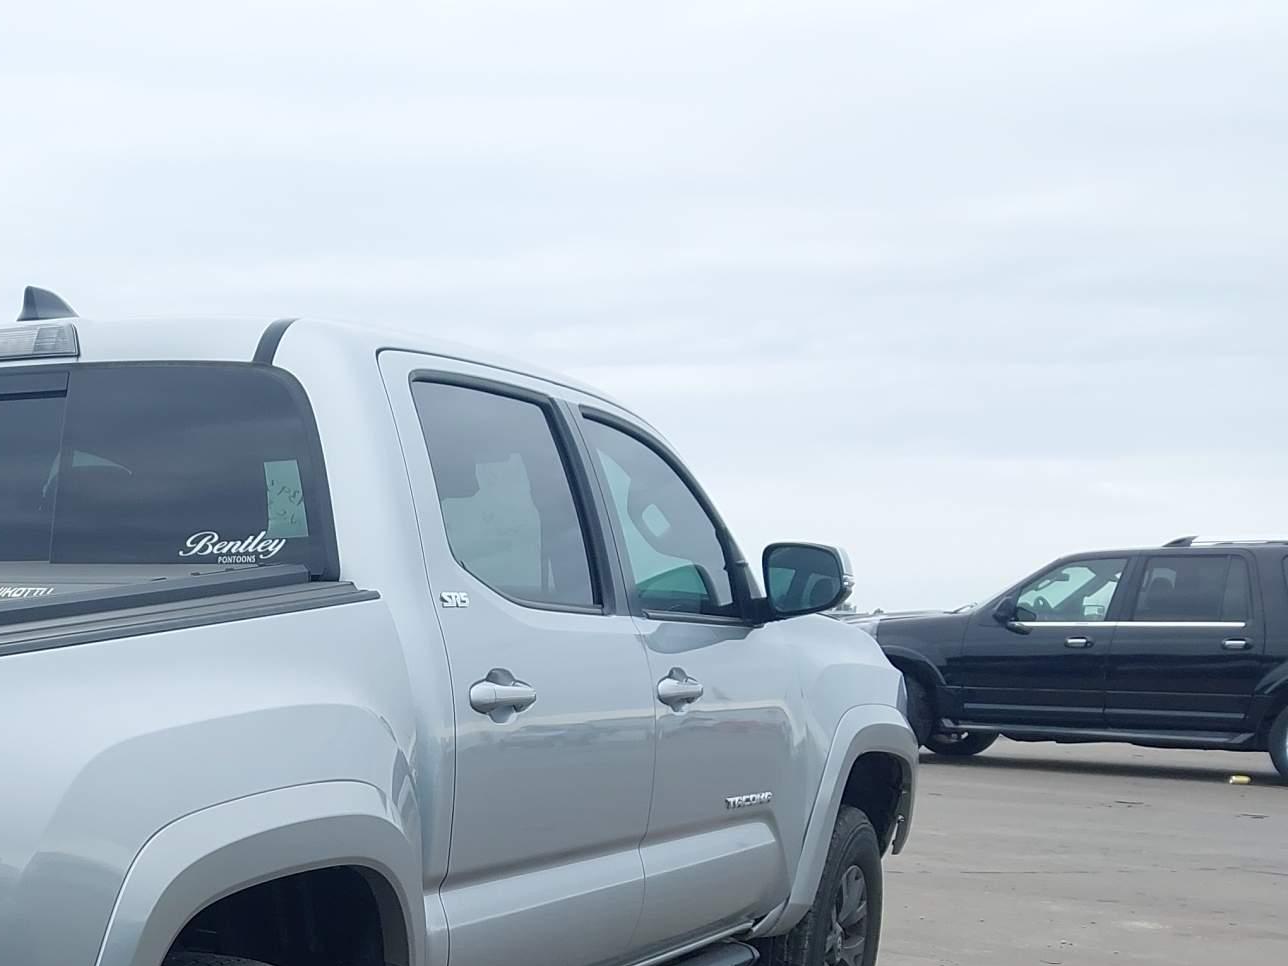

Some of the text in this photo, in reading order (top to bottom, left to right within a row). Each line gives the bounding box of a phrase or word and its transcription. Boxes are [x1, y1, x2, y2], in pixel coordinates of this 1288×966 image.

[178, 531, 287, 559] Bentley
[217, 554, 257, 564] PONTOONS
[440, 591, 470, 608] SR5
[724, 791, 773, 809] TACOMA
